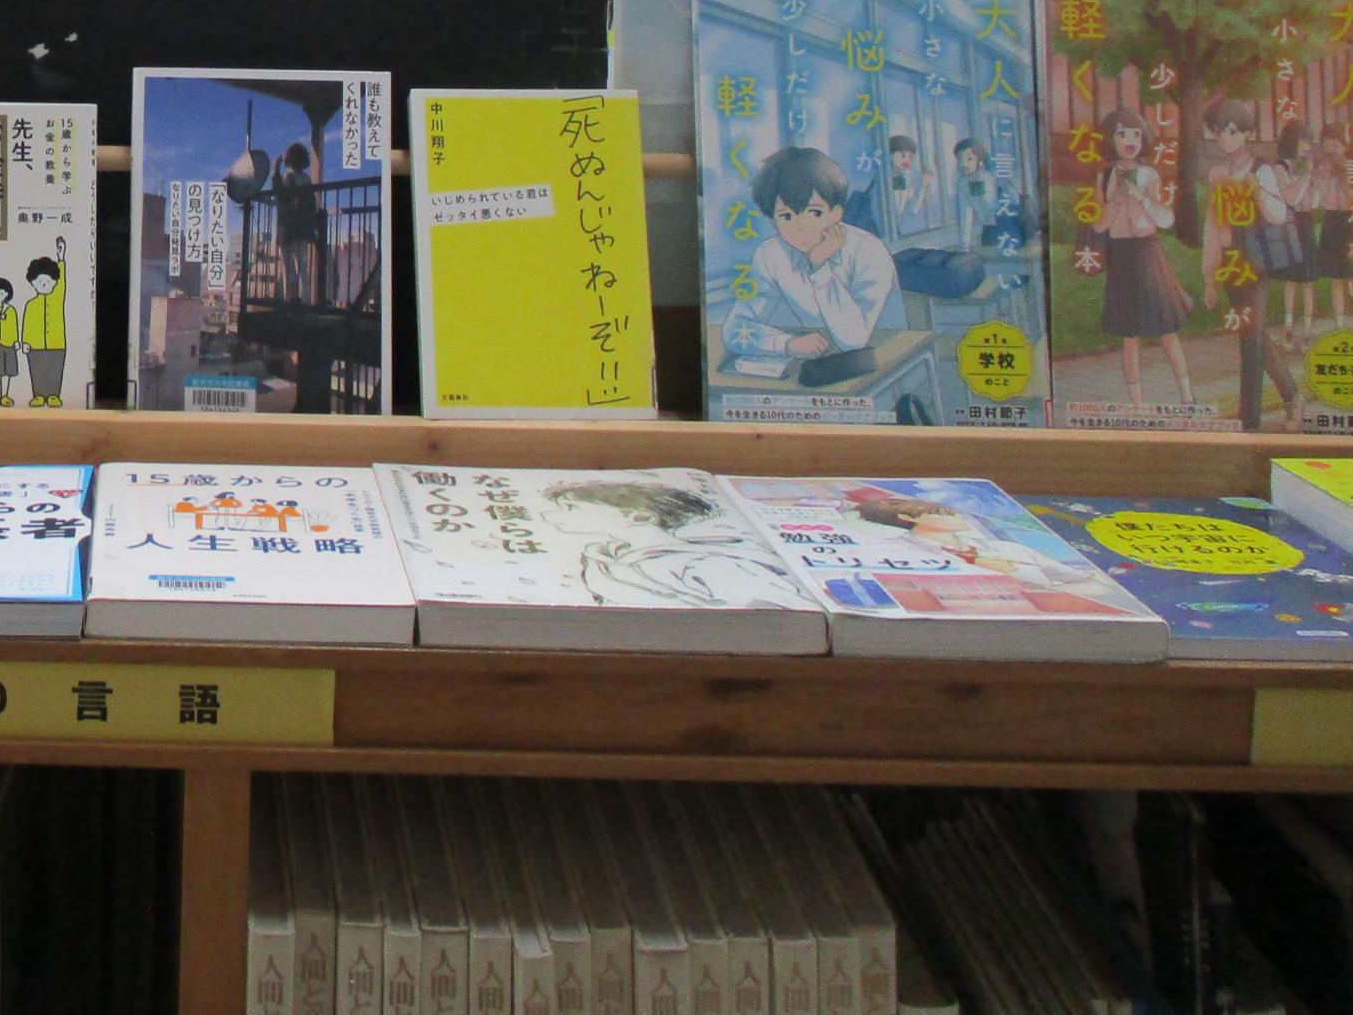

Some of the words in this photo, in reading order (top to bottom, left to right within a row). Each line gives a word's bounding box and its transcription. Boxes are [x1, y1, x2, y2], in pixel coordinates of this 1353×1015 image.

[840, 28, 888, 173] 悩みが
[1271, 18, 1298, 120] 小さな
[12, 118, 33, 171] 先生、
[344, 82, 360, 167] くれなかった
[366, 81, 382, 158] 誰も教えて
[430, 102, 445, 165] 中川翔子
[1150, 63, 1177, 208] 少しだけ
[45, 119, 55, 185] お金の教養
[60, 118, 73, 195] 15歳から学ぶ
[17, 212, 73, 224] 奥野一成
[187, 184, 203, 259] の見つけ方
[431, 187, 549, 206] いじめられている君は
[433, 206, 527, 222] ゼッタイ悪くない
[716, 75, 760, 347] 軽くなる本
[208, 182, 227, 290] 「なりたい自分」
[1211, 179, 1258, 331] 悩みが
[978, 352, 1015, 370] 学校
[1333, 387, 1353, 395] のこ
[125, 473, 348, 488] 15歳からの
[412, 470, 475, 533] 働くのか
[127, 533, 364, 554] 人生戦略
[473, 473, 548, 554] なぜ僕らは
[778, 531, 853, 545] 勉強
[1116, 522, 1225, 533] 僕たちは
[800, 554, 952, 570] トリセツ
[1129, 544, 1267, 555] 行けるのか
